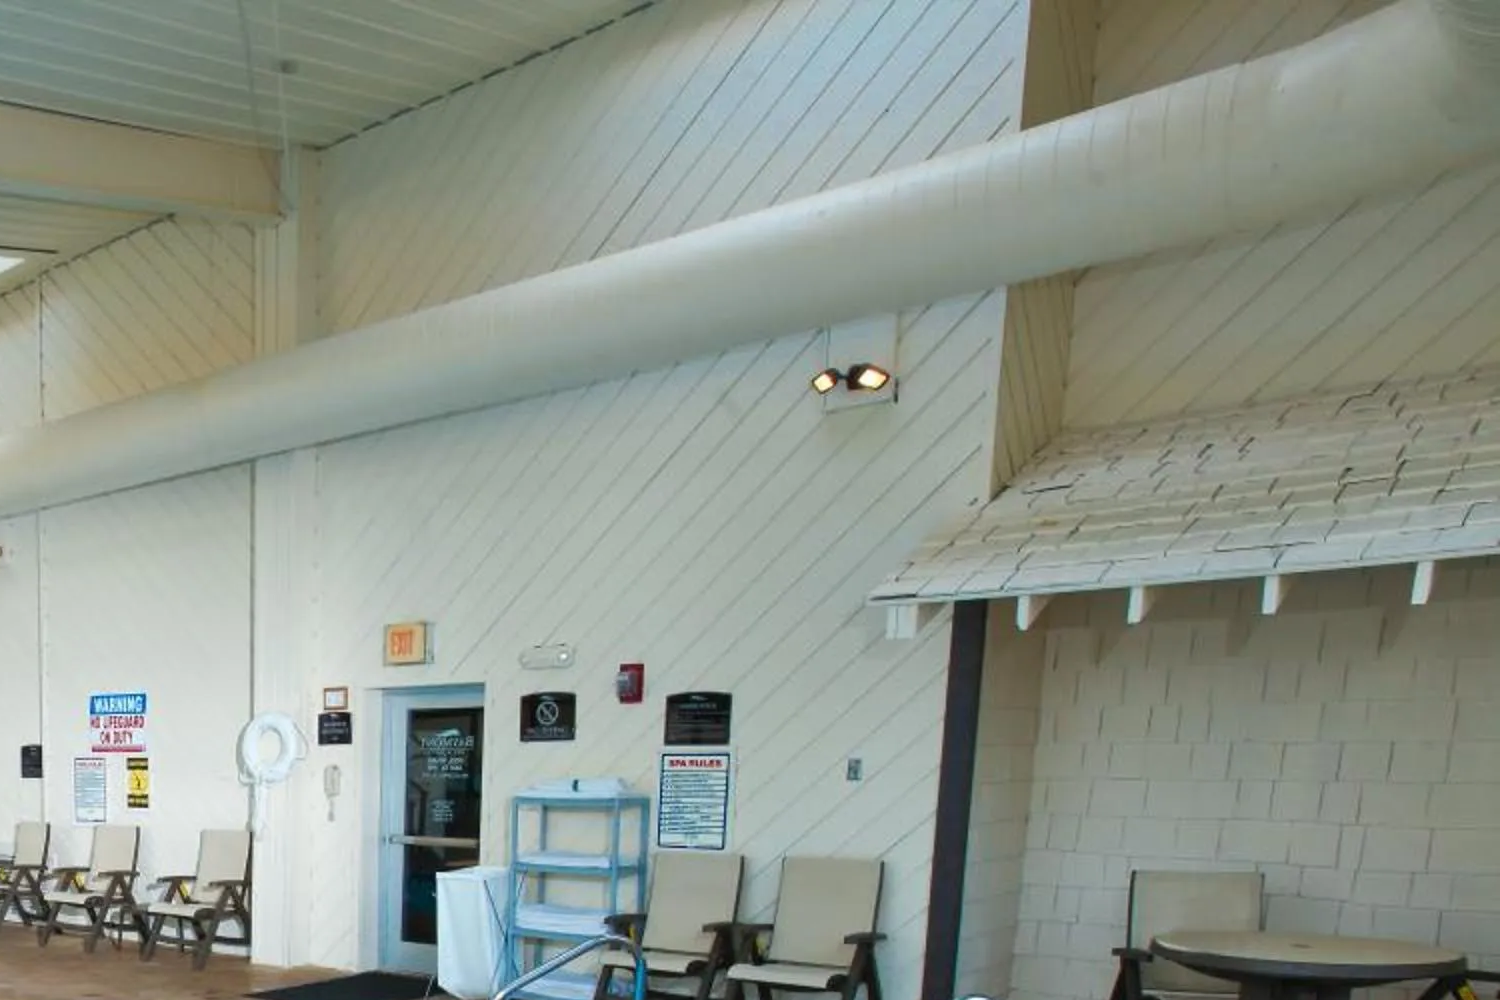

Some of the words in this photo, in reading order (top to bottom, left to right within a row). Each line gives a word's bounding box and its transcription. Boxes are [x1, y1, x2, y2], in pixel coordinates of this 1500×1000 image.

[390, 629, 413, 656] EXIT
[93, 695, 144, 713] WARNING
[90, 715, 101, 729] NO
[102, 715, 145, 729] LIFEGUARD
[100, 731, 111, 745] ON
[113, 731, 133, 744] DUTY
[668, 759, 687, 768] SPA
[688, 759, 723, 768] RULES
